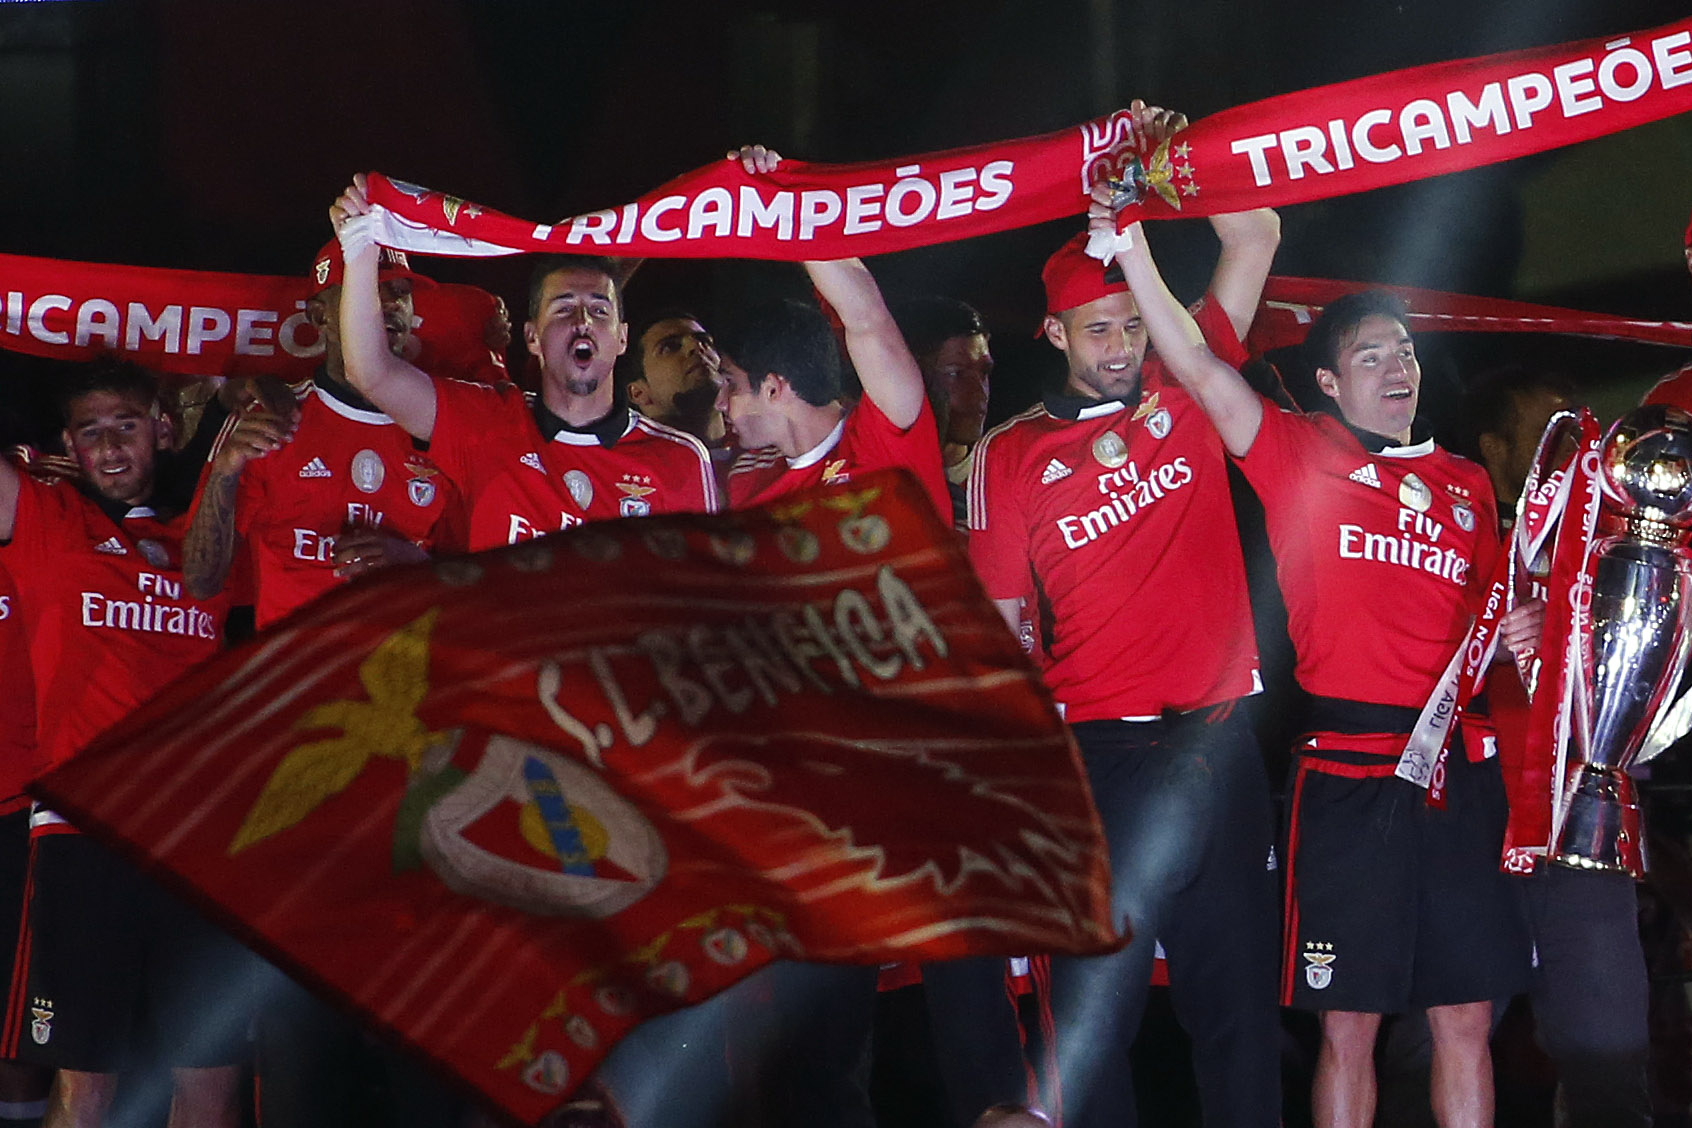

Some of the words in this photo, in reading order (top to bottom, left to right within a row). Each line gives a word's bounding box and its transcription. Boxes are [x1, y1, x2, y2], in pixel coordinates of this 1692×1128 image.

[1056, 456, 1193, 550] Emirates
[1397, 507, 1443, 543] Fly
[138, 571, 181, 601] Fly
[1482, 581, 1505, 621] LIGA
[81, 591, 216, 640] Emirates
[1465, 625, 1489, 678] NOS
